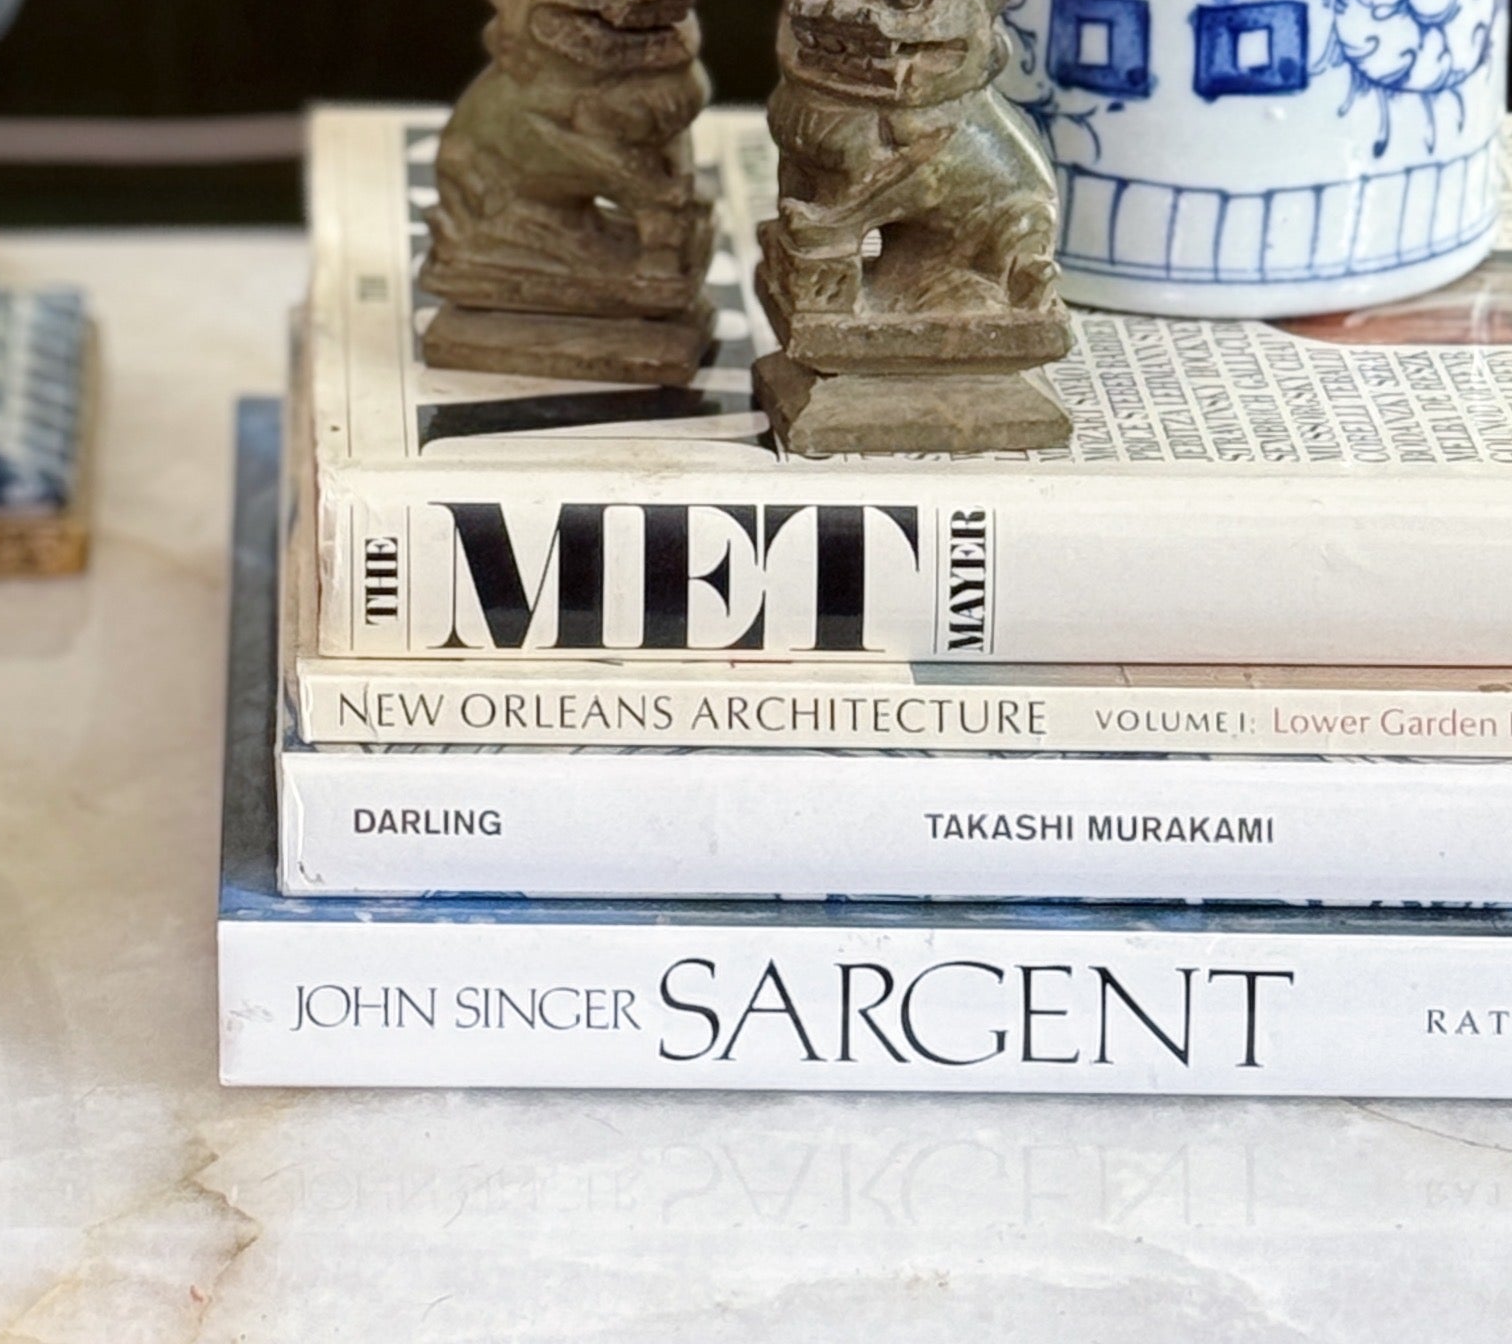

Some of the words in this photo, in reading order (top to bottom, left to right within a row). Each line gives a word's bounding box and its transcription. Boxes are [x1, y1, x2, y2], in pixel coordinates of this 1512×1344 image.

[1099, 372, 1149, 420] STEBER
[1133, 344, 1189, 406] LEHMANN
[1304, 347, 1363, 402] TEBALDI
[1191, 383, 1256, 463] STRAVINSKY
[1240, 394, 1301, 463] SEMBRICH
[1273, 374, 1345, 463] MUSSORGSKY
[1368, 390, 1437, 463] BODANZKY
[1416, 394, 1458, 412] DE
[1070, 410, 1120, 463] MOZART
[1116, 421, 1172, 463] PRICE
[1159, 411, 1216, 463] JERITZA
[1332, 404, 1392, 463] CORELLI
[1428, 415, 1484, 463] MELBA
[364, 537, 399, 625] THE
[427, 502, 921, 653] MET
[947, 509, 988, 652] MAYER
[337, 691, 445, 728] NEW
[460, 692, 673, 731] ORLEANS
[691, 695, 1047, 736] ARCHITECTURE
[1095, 709, 1229, 733] VOLUME
[1273, 706, 1372, 736] Lower
[1380, 707, 1498, 738] Garden
[353, 807, 503, 837] DARLING
[924, 813, 1074, 841] TAKASHI
[1087, 814, 1274, 843] MURAKAMI
[290, 984, 437, 1031] JOHN
[455, 986, 642, 1031] SINGER
[658, 957, 1295, 1069] SARGENT
[1426, 1008, 1510, 1035] RAT
